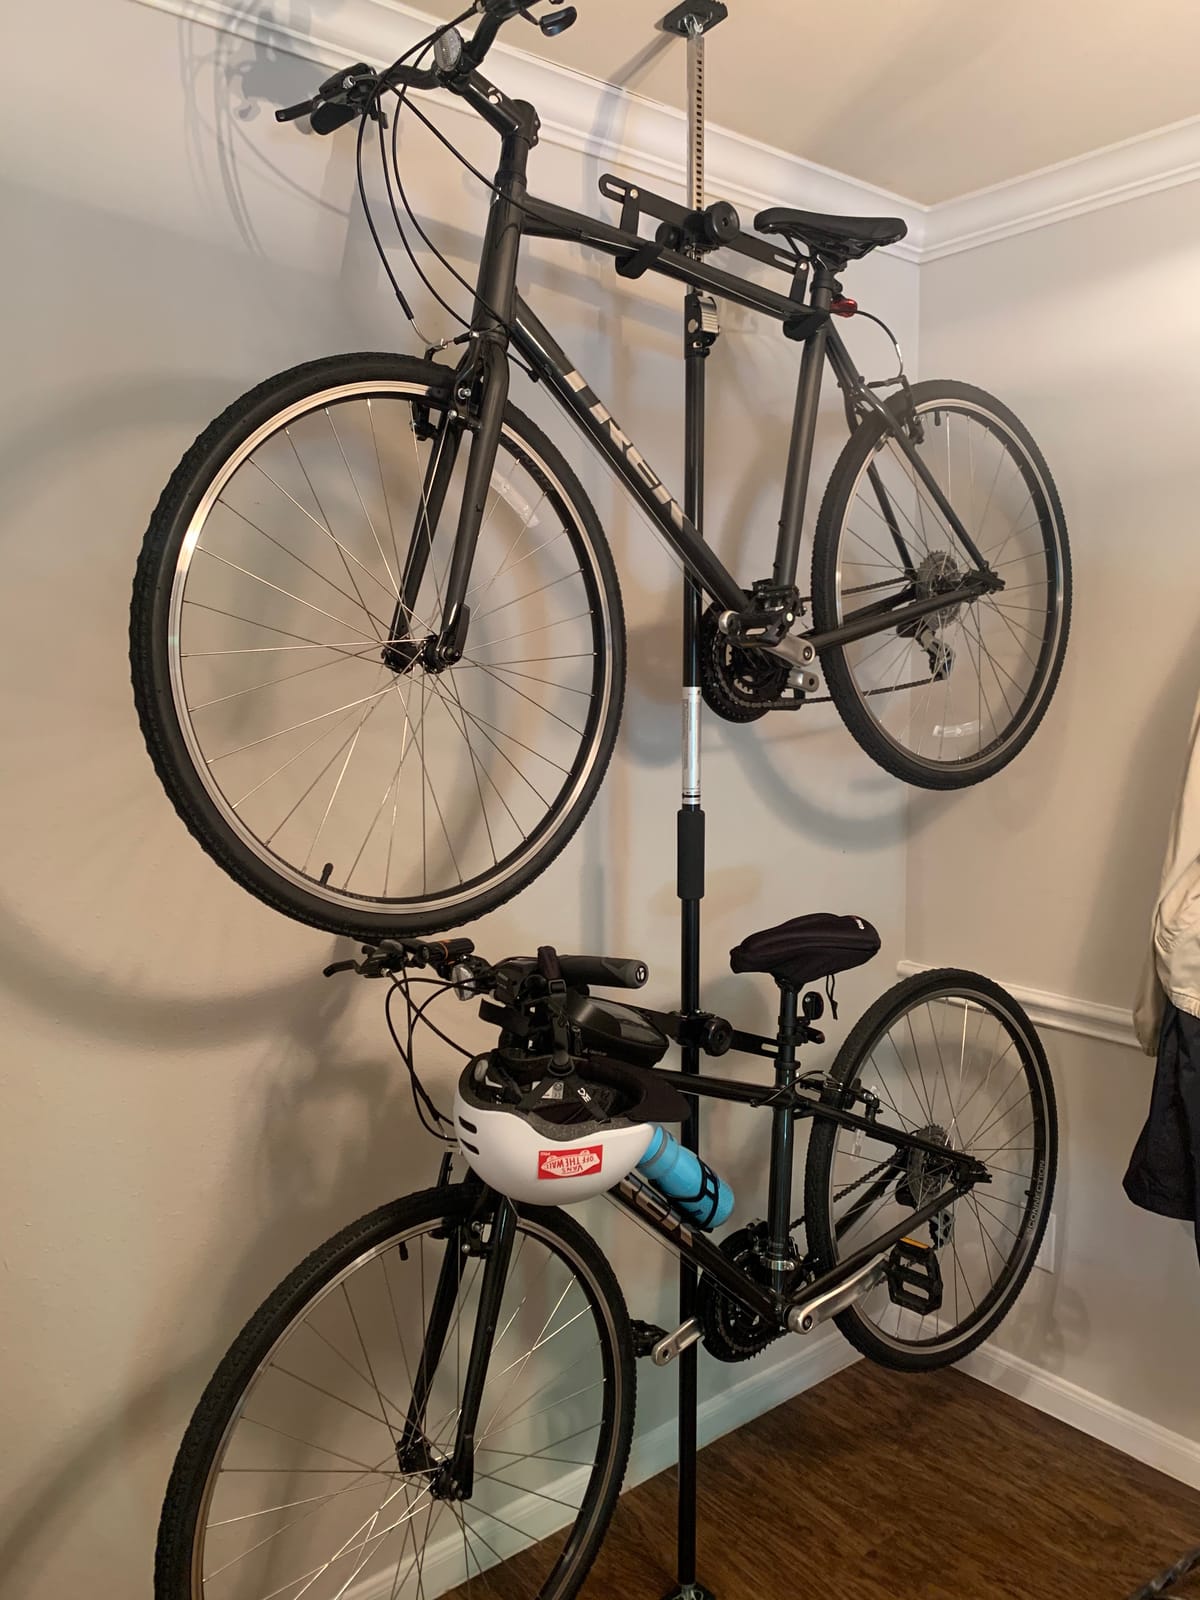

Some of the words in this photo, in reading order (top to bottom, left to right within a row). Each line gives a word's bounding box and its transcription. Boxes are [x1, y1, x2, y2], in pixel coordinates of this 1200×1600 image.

[565, 1156, 580, 1166] THE
[583, 1156, 594, 1164] OFF
[561, 1164, 583, 1173] VANS
